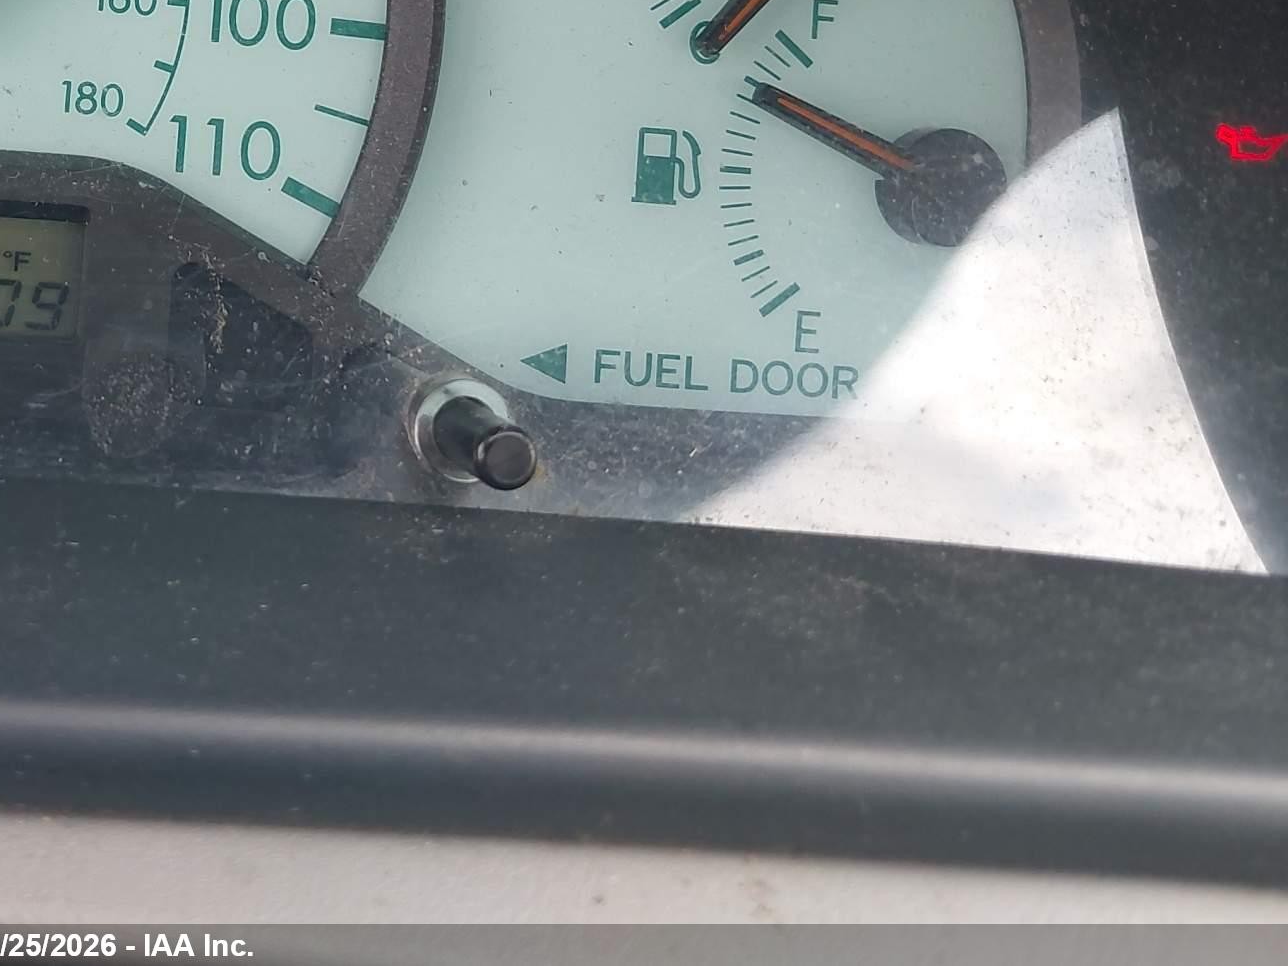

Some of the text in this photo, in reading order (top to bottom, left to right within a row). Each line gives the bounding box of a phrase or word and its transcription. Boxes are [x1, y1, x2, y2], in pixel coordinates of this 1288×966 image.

[62, 80, 124, 117] 180
[171, 114, 281, 181] 110
[794, 310, 821, 354] E
[594, 349, 859, 400] FUEL DOOR
